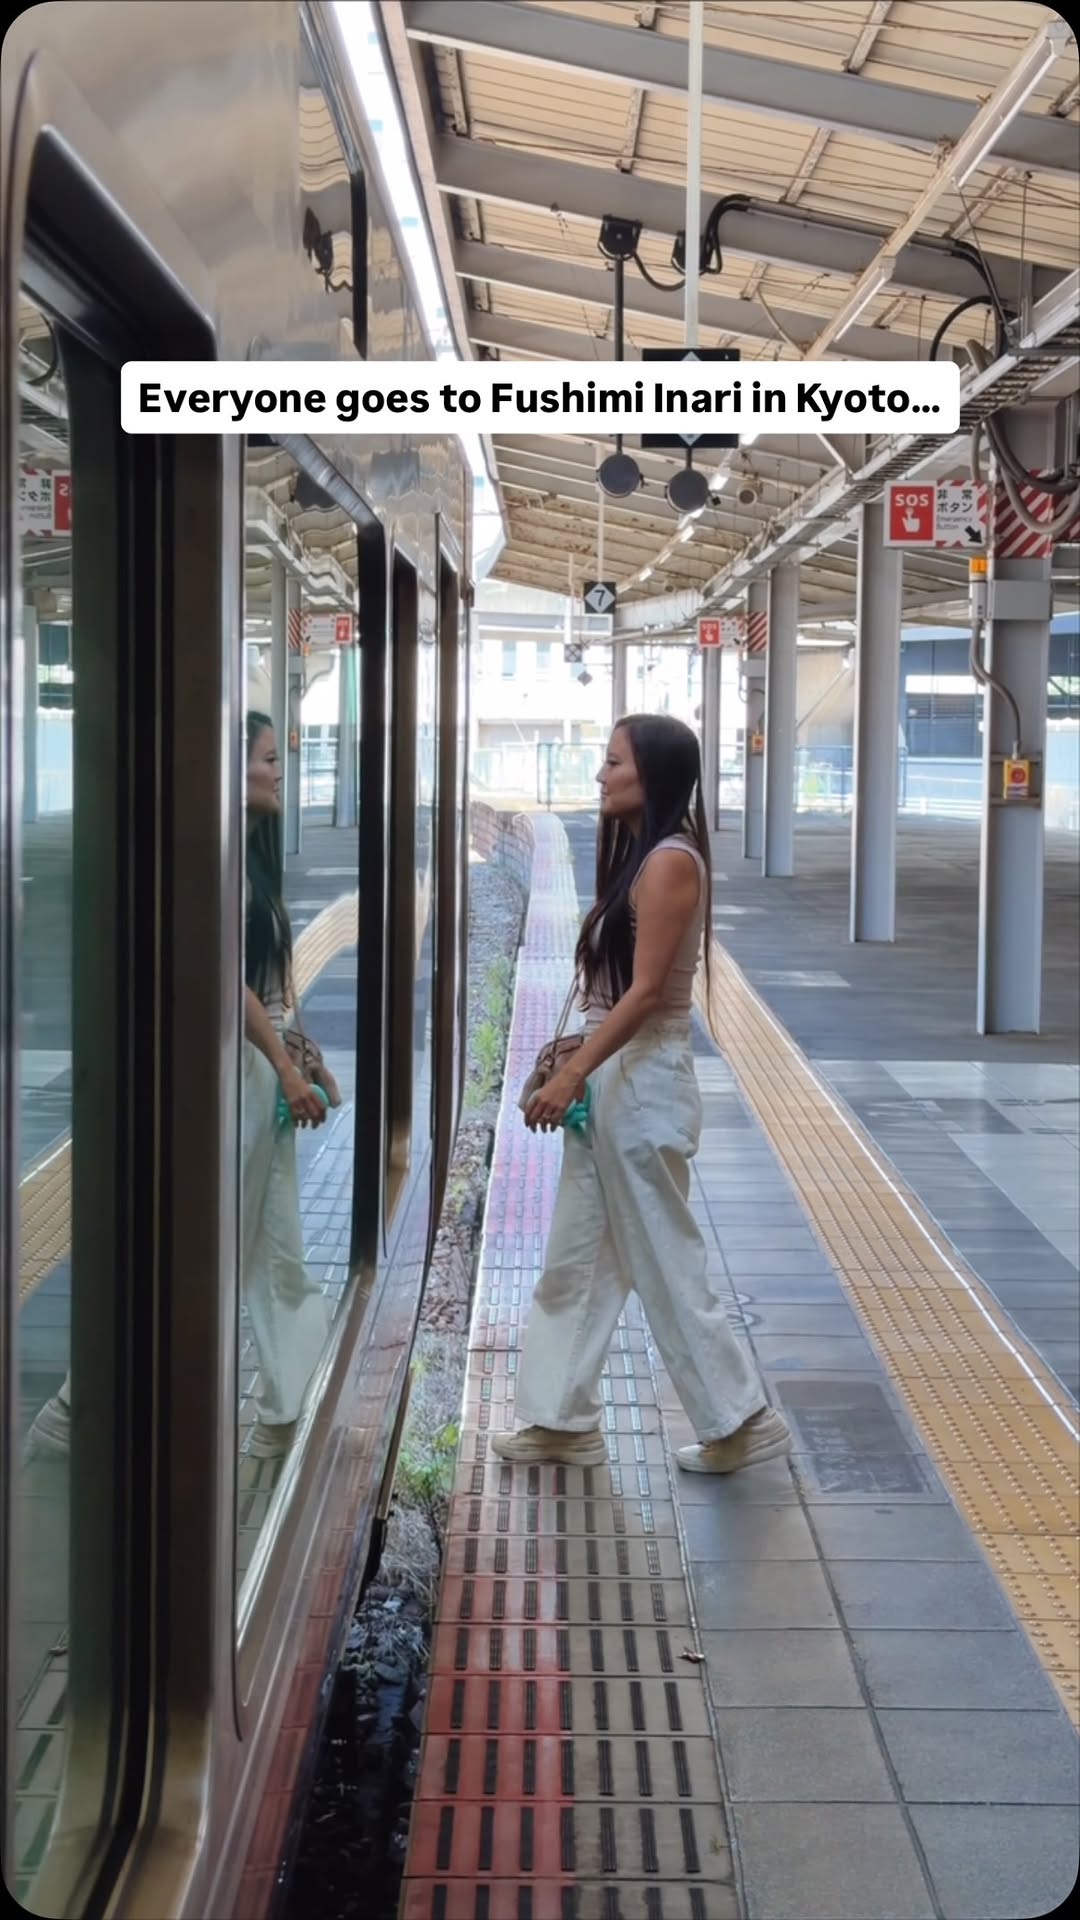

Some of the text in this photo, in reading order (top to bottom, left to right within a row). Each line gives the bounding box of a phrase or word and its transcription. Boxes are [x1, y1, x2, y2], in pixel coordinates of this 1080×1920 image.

[896, 494, 929, 506] SOS
[937, 502, 973, 513] ボタン
[594, 589, 606, 607] 7
